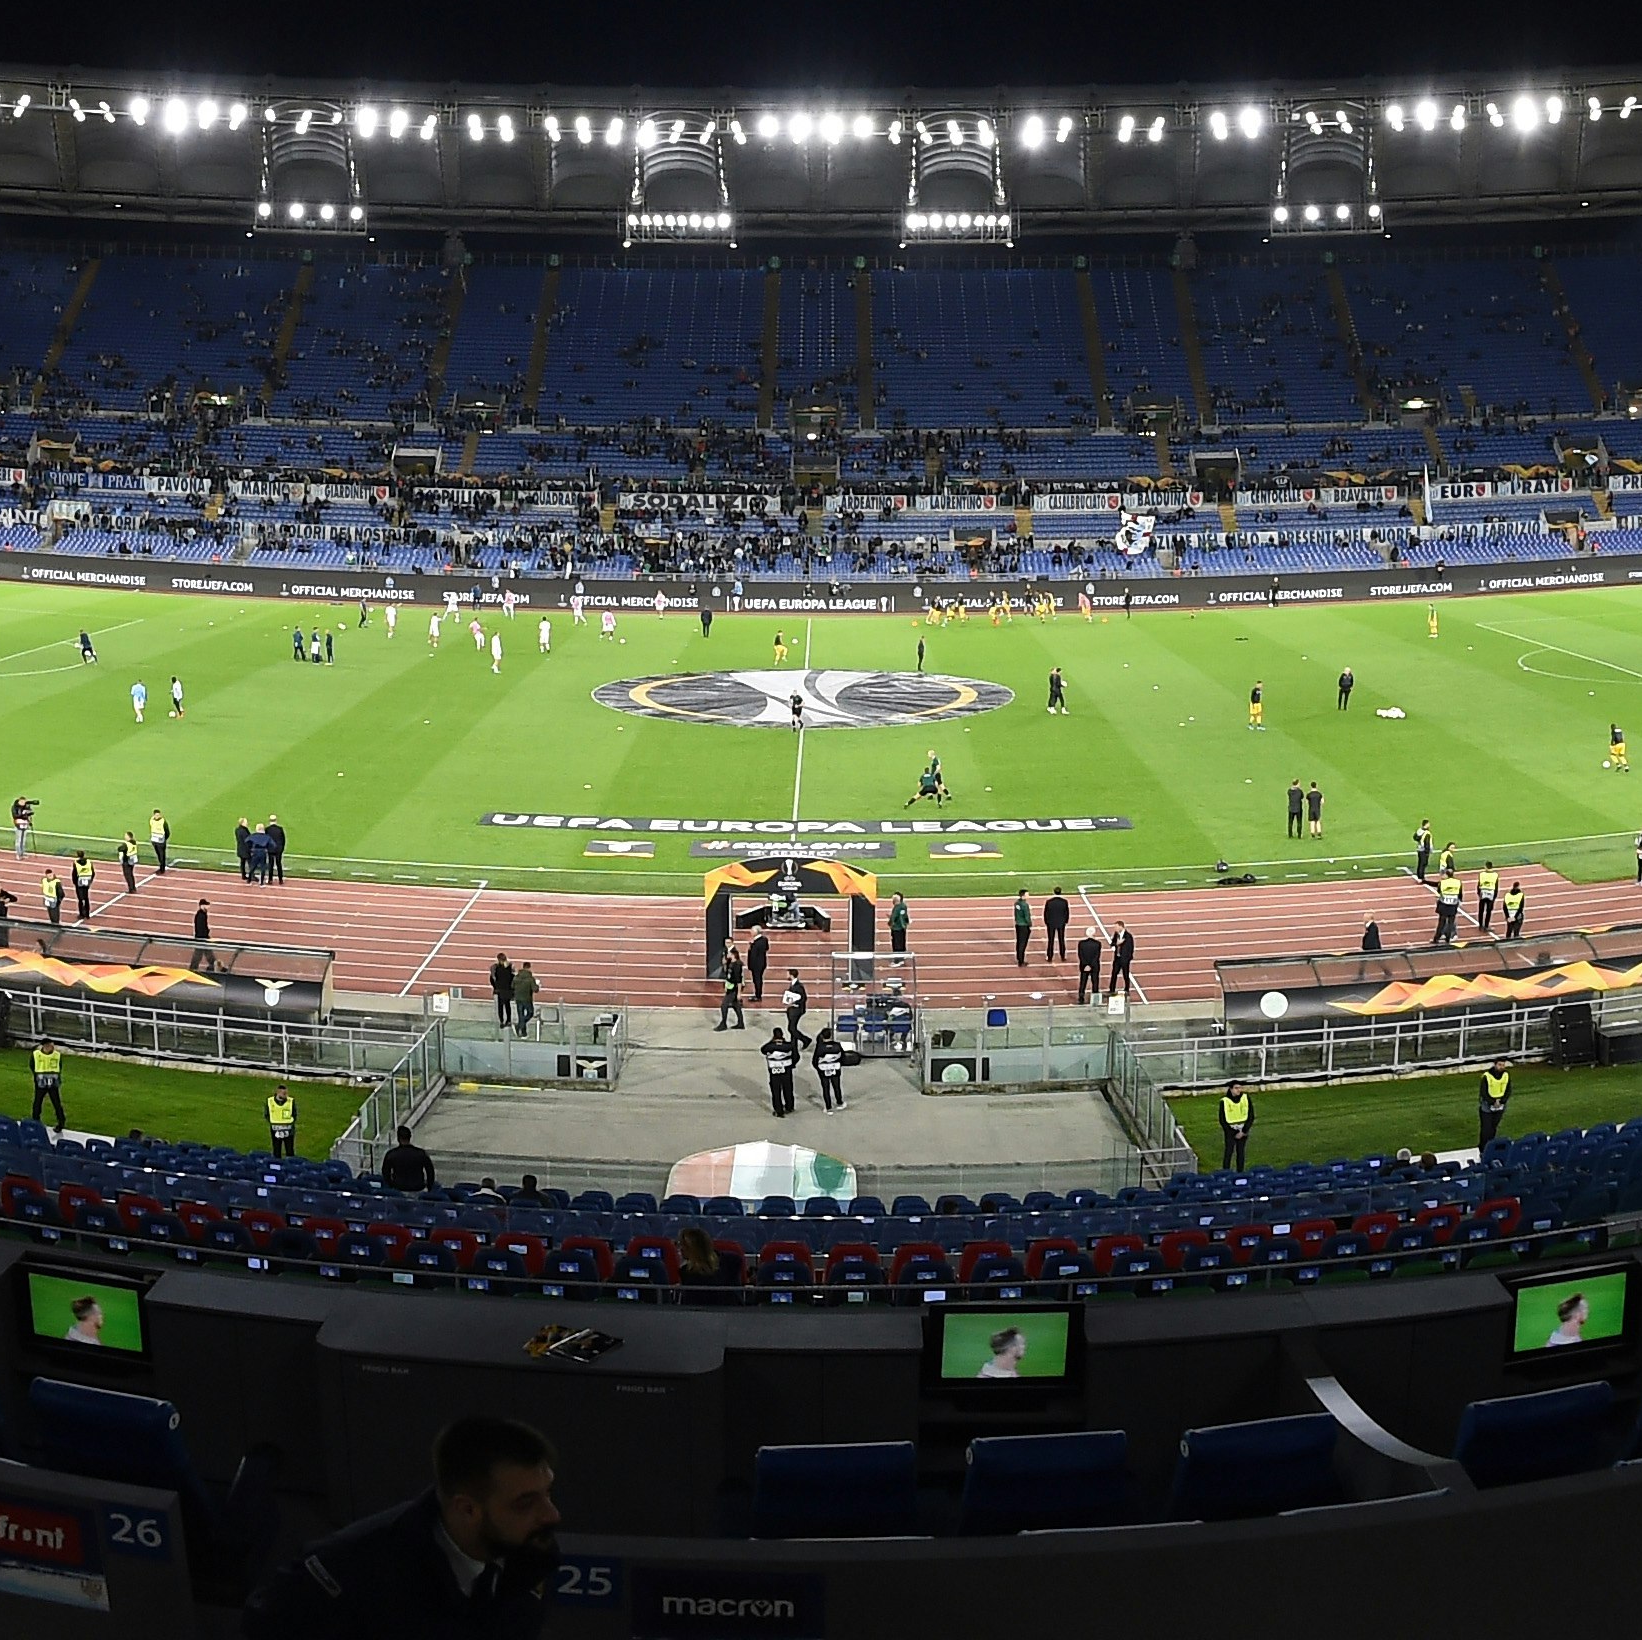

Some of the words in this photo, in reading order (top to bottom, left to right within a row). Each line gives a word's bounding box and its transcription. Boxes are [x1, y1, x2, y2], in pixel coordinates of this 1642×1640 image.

[157, 477, 205, 492] PAVONA
[1440, 484, 1474, 498] EUR
[1137, 492, 1188, 507] BALDUINA
[1250, 489, 1301, 504] CENTOCELLE
[1334, 486, 1384, 502] BRAVETTA
[841, 495, 893, 509] ARDEATINO
[930, 495, 983, 509] LAURENTINO
[1483, 521, 1541, 538] FABRIZIO
[32, 568, 75, 582] OFFICIAL
[77, 571, 146, 586] MERCHANDISE
[1489, 577, 1534, 589] OFFICIAL
[1536, 572, 1604, 586] MERCHANDISE
[171, 578, 254, 593] STORE.UEFA.COM
[291, 585, 339, 598] OFFICIAL
[341, 587, 415, 601] MERCHANDISE
[1370, 582, 1453, 596] STORE.UEFA.COM
[744, 598, 777, 610] UEFA
[779, 598, 827, 610] EUROPA
[829, 598, 877, 610] LEAGUE
[1219, 591, 1266, 603] OFFICIAL
[491, 813, 633, 831] UEFA
[648, 819, 867, 834] EUROPA
[391, 1366, 410, 1375] BAR
[616, 1384, 645, 1393] FRIGO
[647, 1386, 666, 1395] BAR
[108, 1512, 163, 1548] 26
[556, 1564, 614, 1597] 25
[661, 1595, 795, 1619] macron
